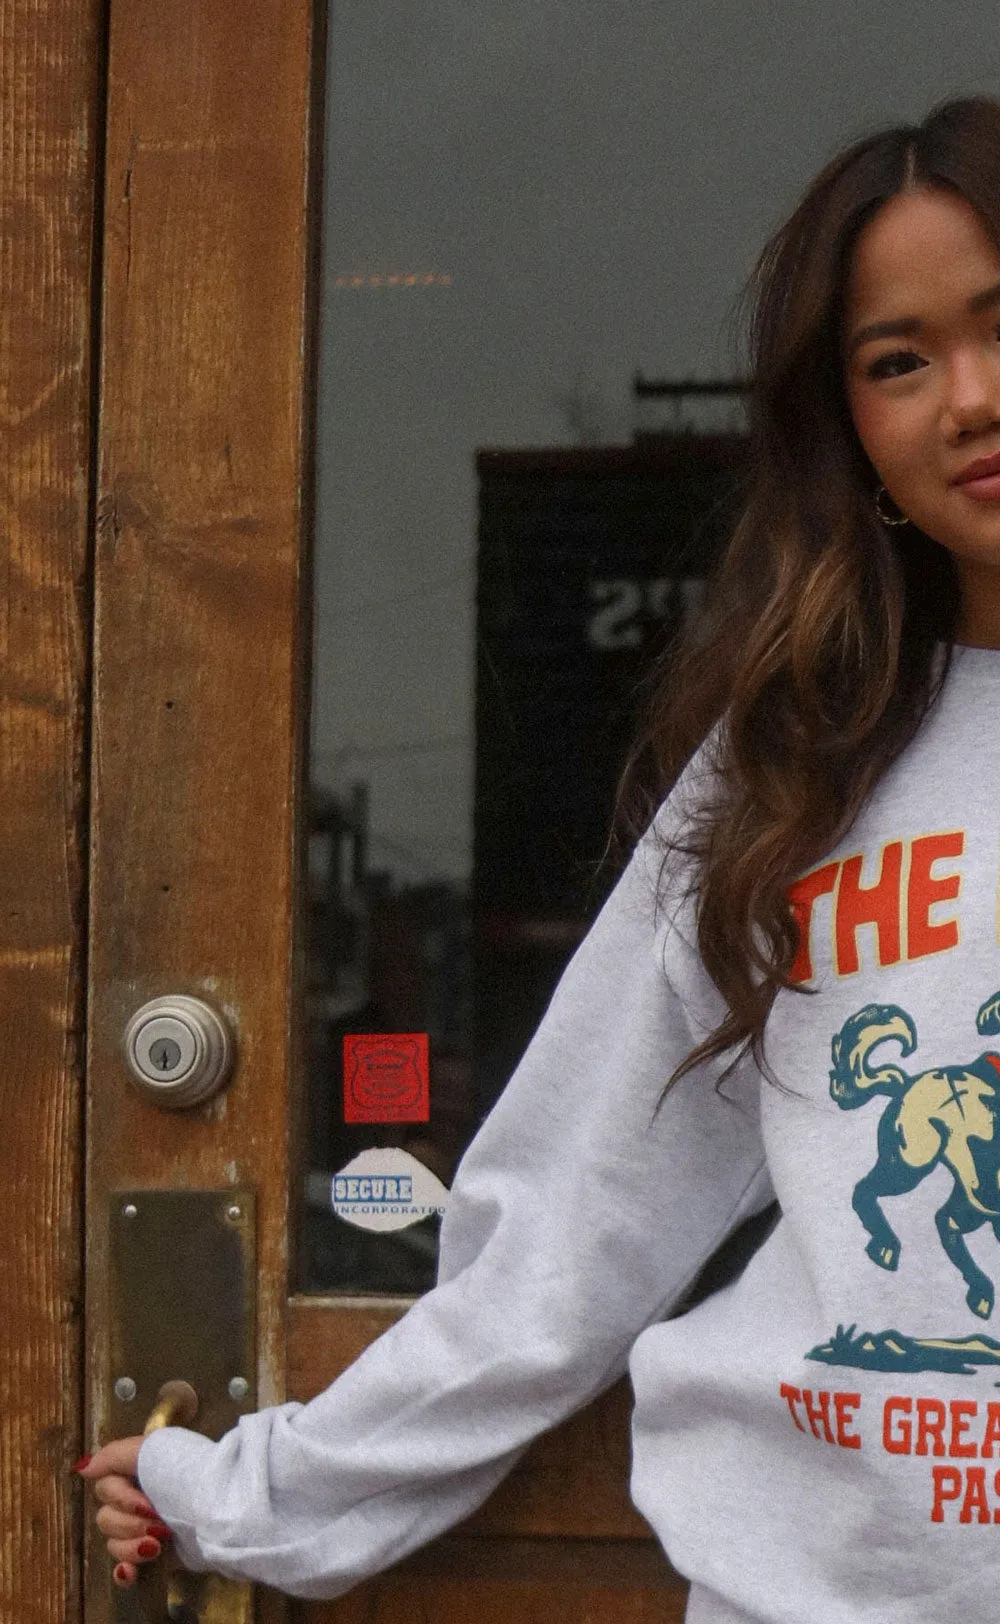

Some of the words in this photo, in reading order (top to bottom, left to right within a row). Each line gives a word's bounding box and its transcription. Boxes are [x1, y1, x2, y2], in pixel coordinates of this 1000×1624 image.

[784, 831, 966, 986] THE
[335, 1178, 413, 1200] SECURE
[780, 1383, 862, 1449] THE
